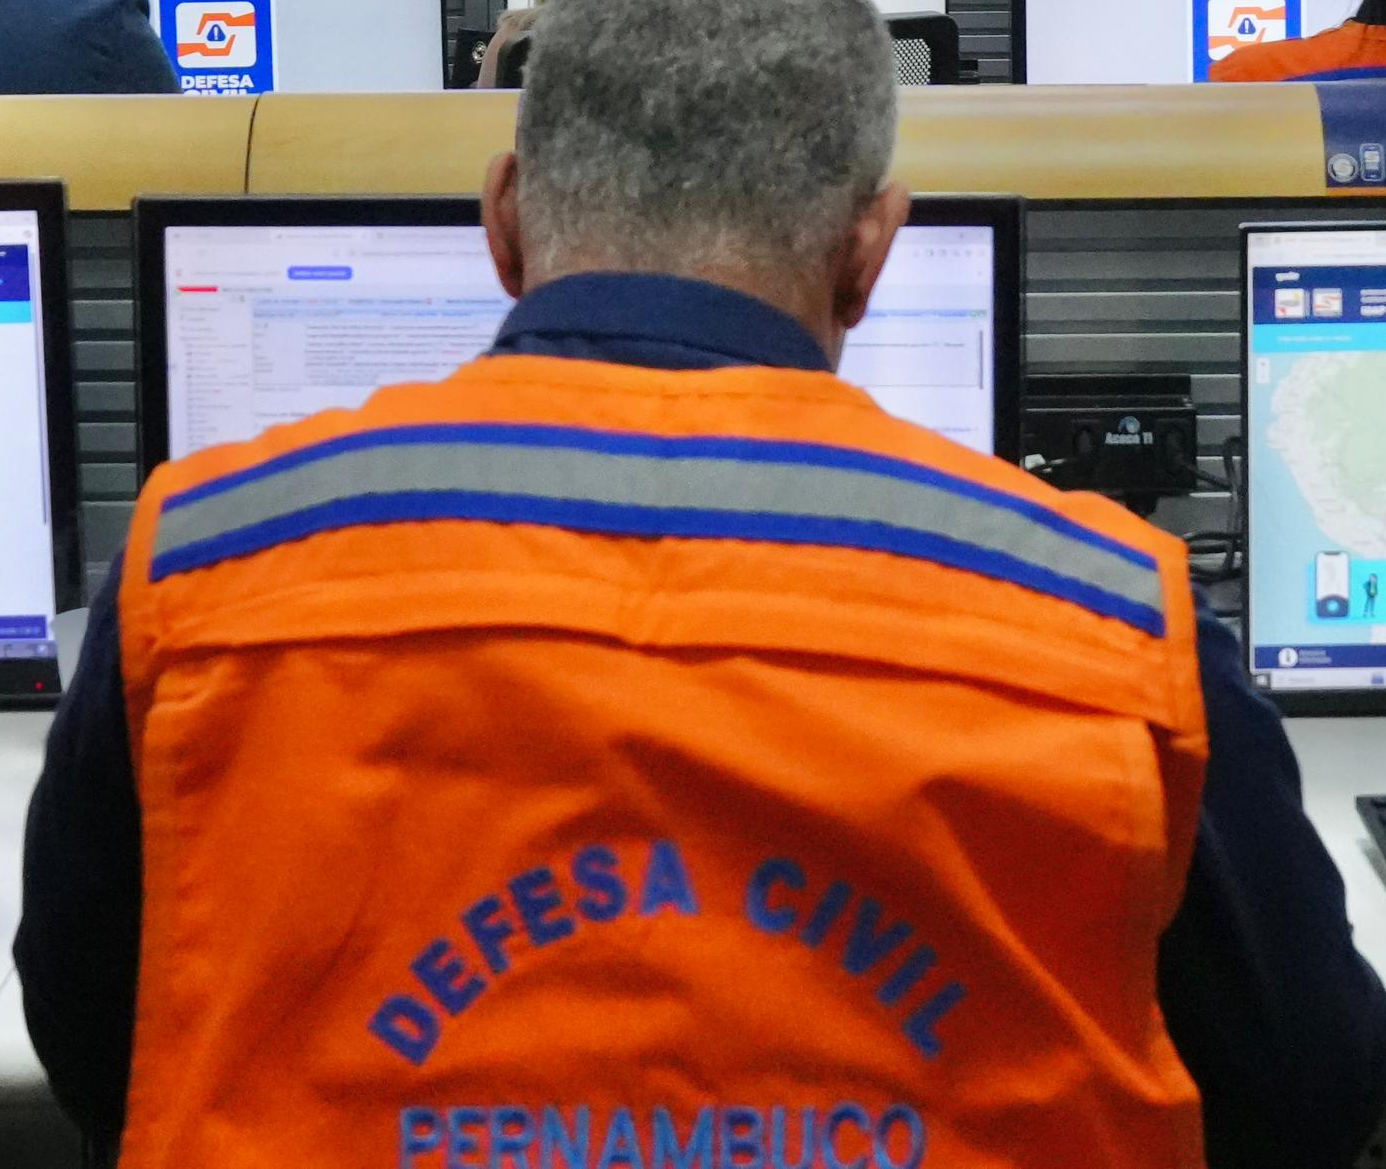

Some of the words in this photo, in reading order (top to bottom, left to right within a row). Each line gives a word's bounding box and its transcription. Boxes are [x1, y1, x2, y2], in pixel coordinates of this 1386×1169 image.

[181, 74, 255, 89] DEFESA
[366, 840, 700, 1068] DEFESA
[745, 857, 969, 1061] CIVIL
[399, 1101, 927, 1169] PERNAMBUCO
